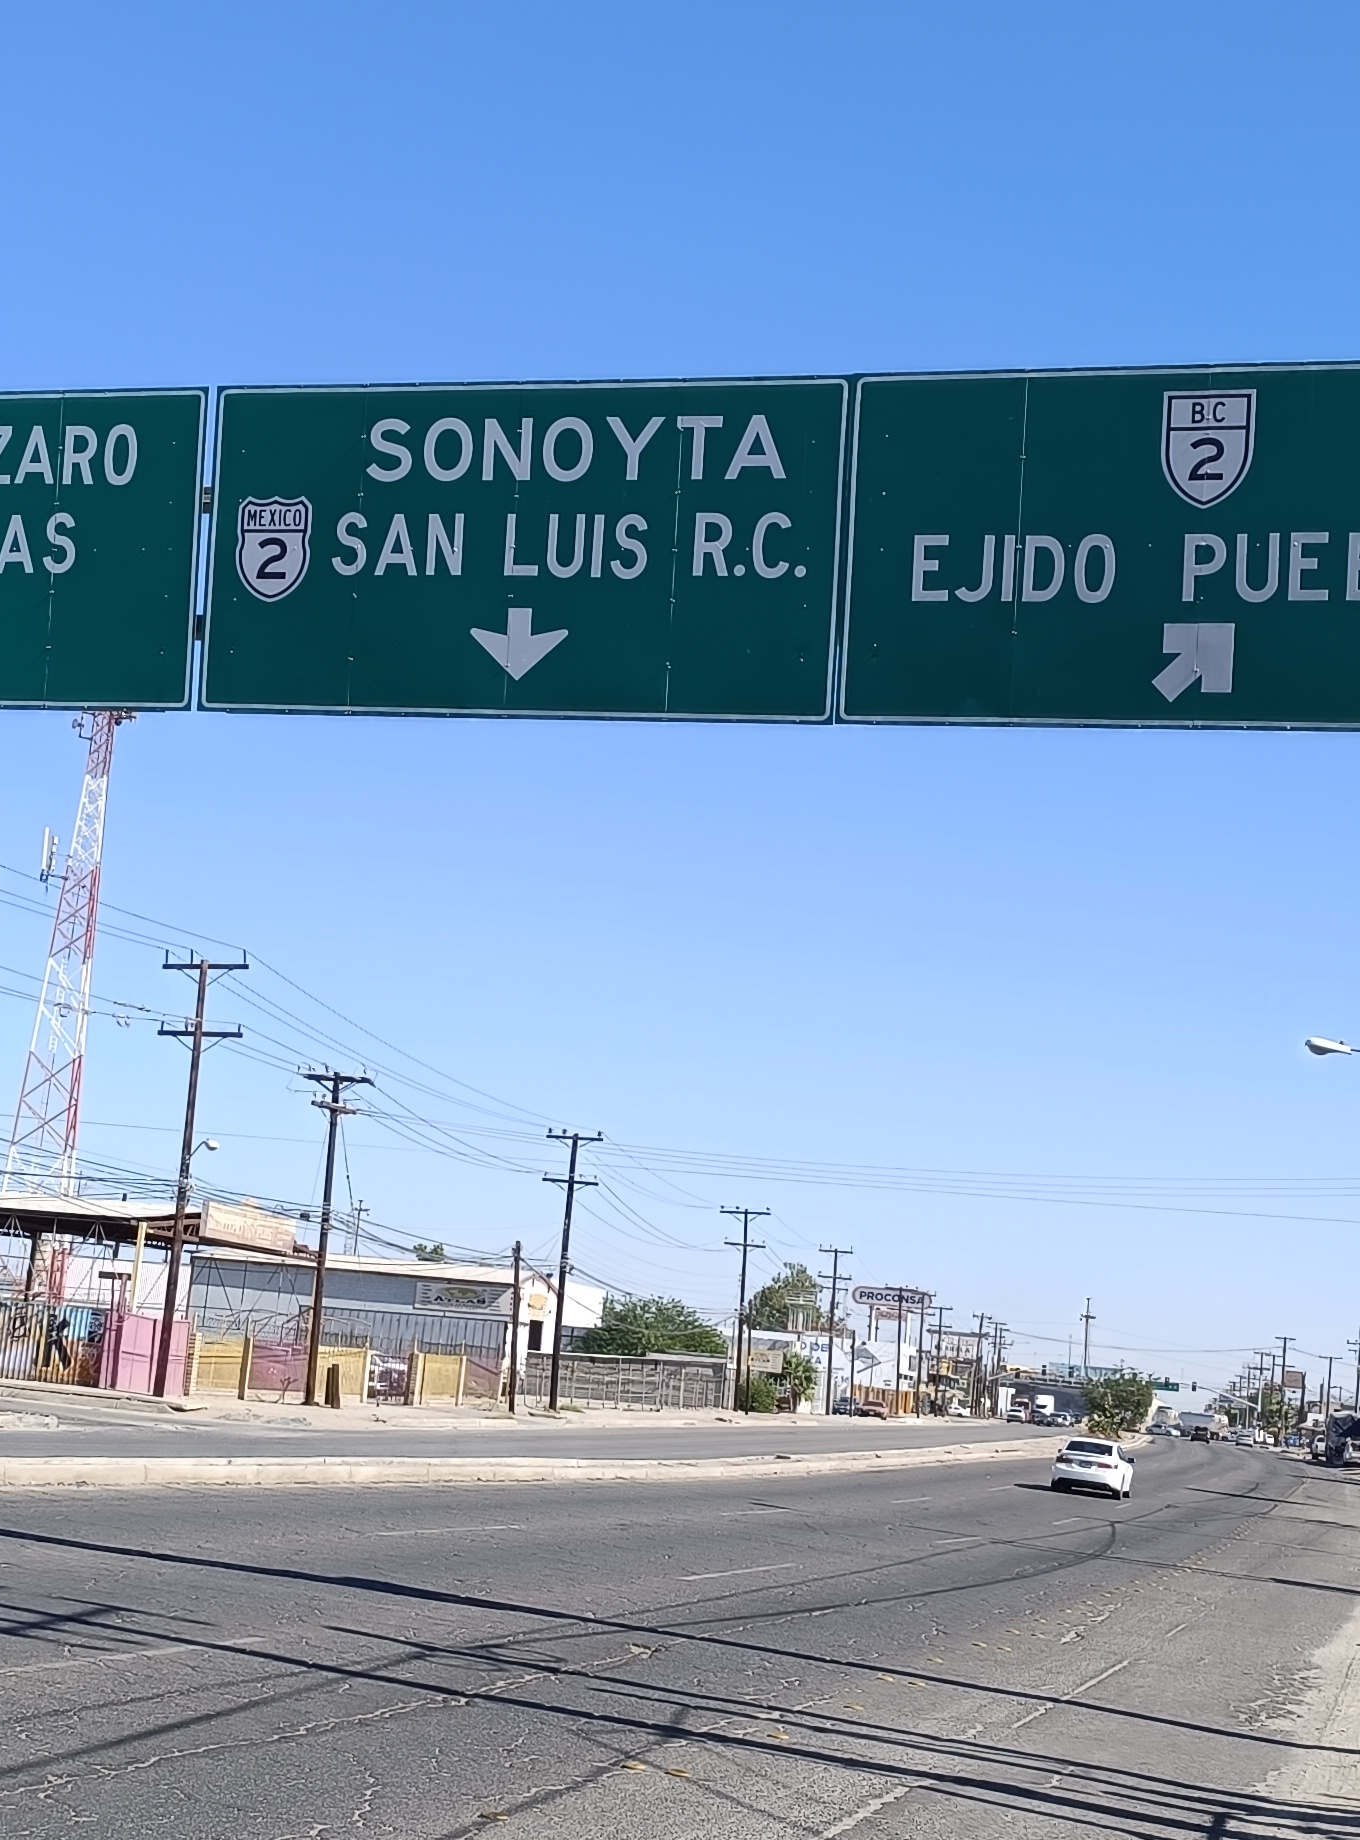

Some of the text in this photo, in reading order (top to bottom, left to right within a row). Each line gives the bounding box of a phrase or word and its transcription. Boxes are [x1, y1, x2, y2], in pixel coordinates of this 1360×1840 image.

[366, 413, 787, 482] SONOYTA
[1187, 437, 1225, 481] 2
[246, 509, 302, 527] MEXICO
[331, 511, 807, 579] SAN LUIS R.C.
[255, 537, 287, 579] 2
[911, 534, 1116, 603] EJIDO
